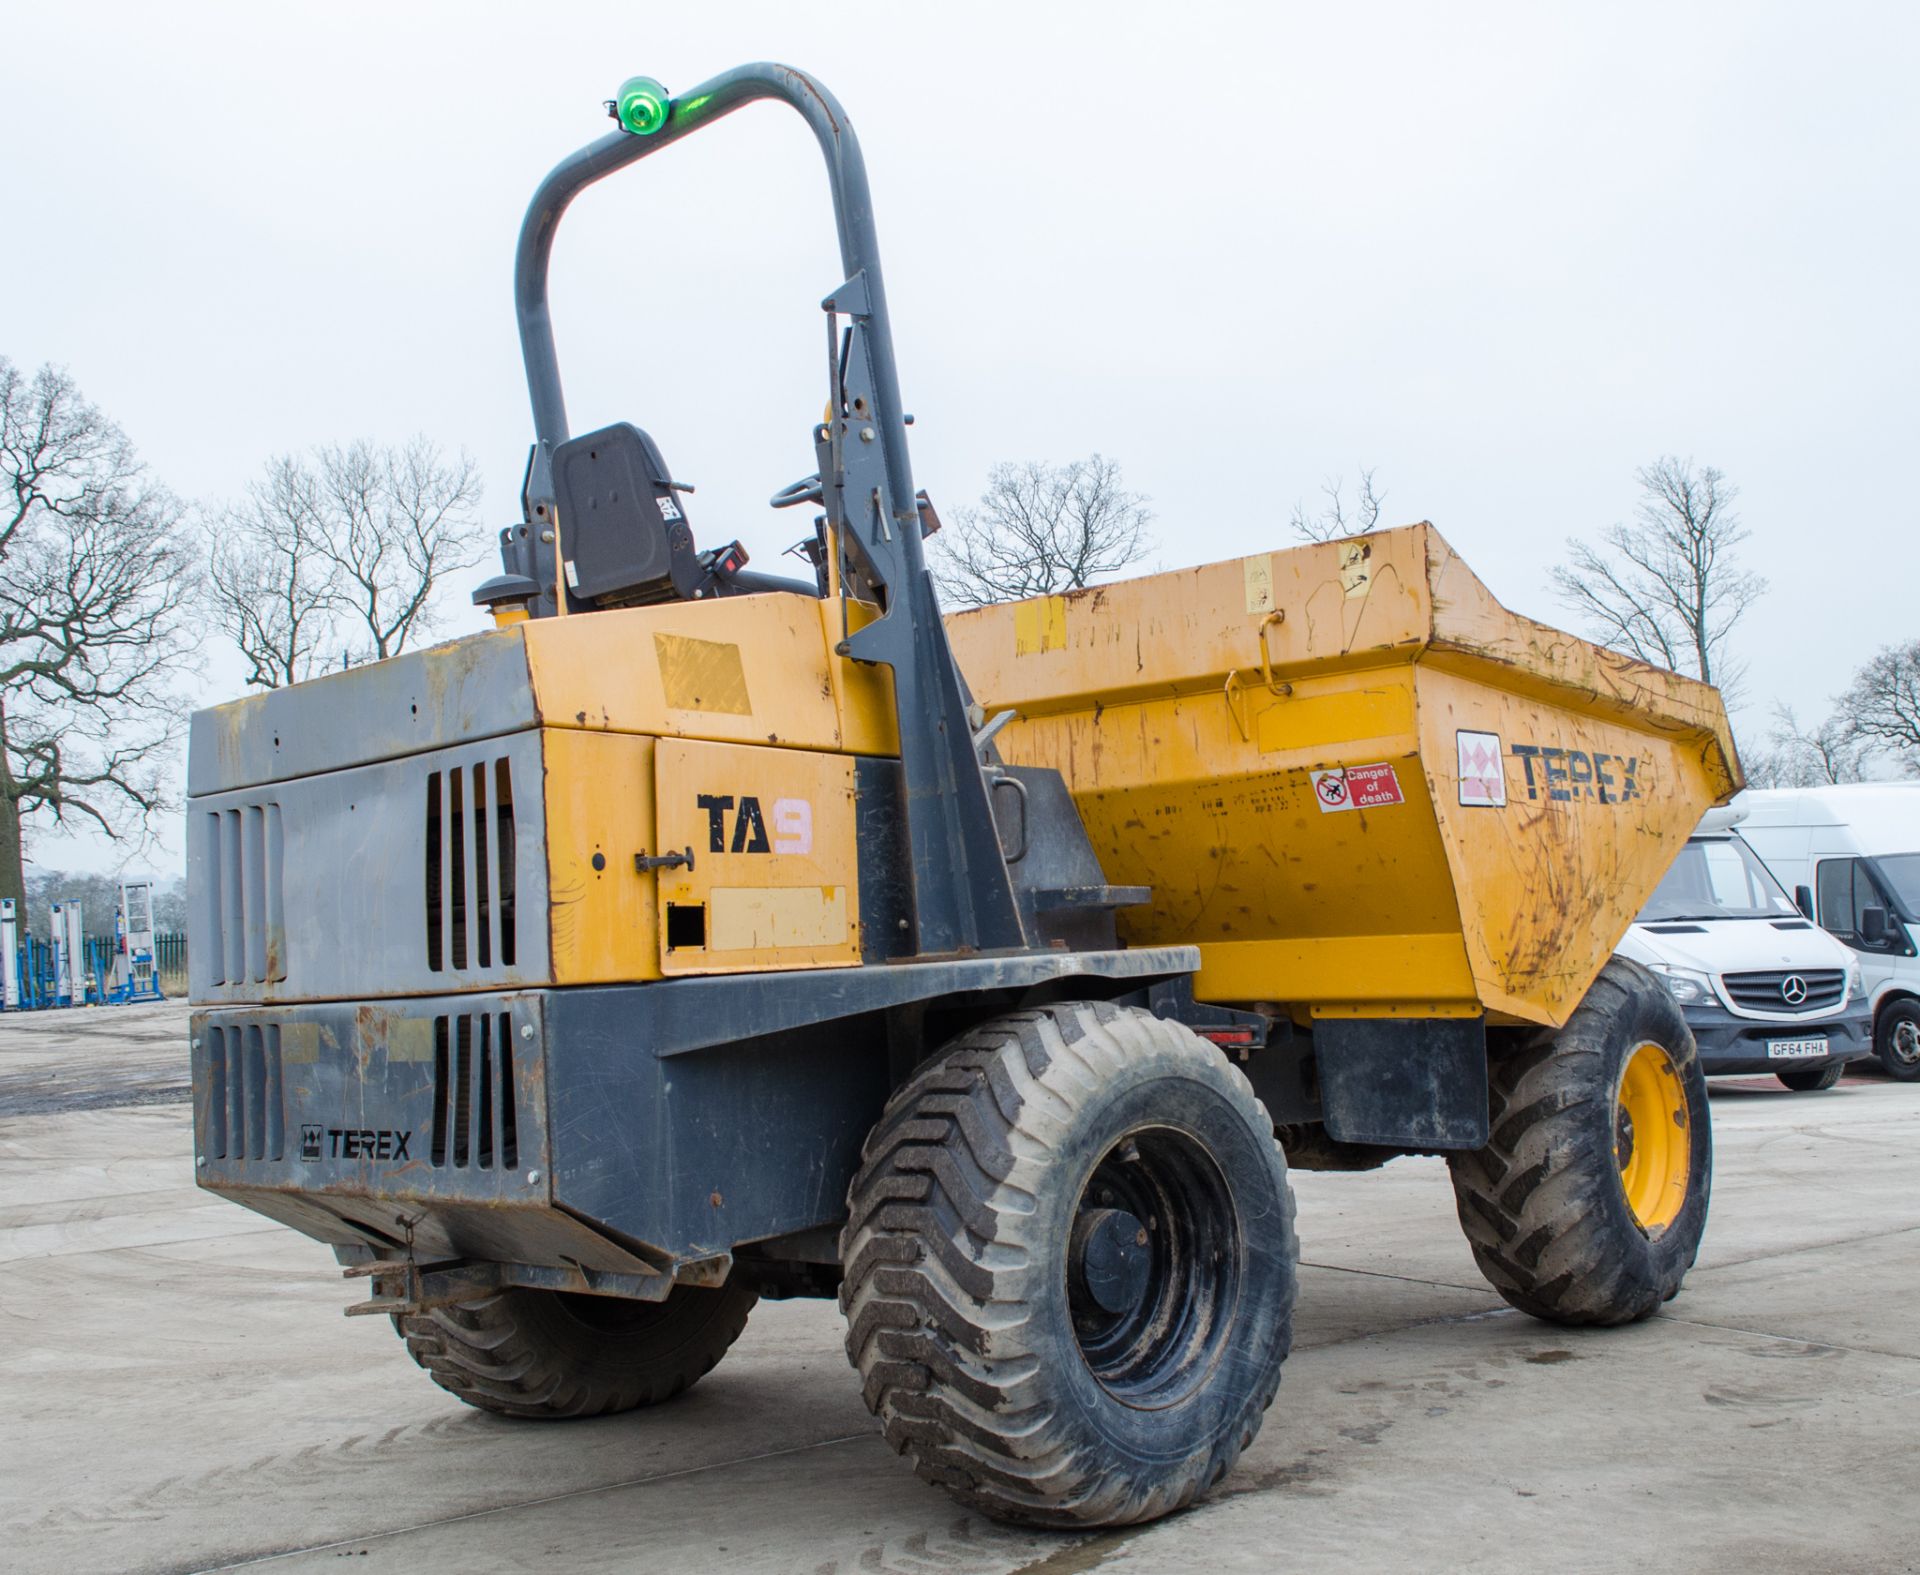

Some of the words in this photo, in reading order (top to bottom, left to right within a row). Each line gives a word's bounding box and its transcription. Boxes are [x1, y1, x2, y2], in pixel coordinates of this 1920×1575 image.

[1511, 744, 1640, 804] TEREX
[1360, 792, 1393, 804] death
[1366, 782, 1379, 791] of
[697, 794, 813, 854] TA9
[1773, 1043, 1802, 1056] GF64
[1805, 1042, 1824, 1054] FHA
[328, 1129, 412, 1161] TEREX
